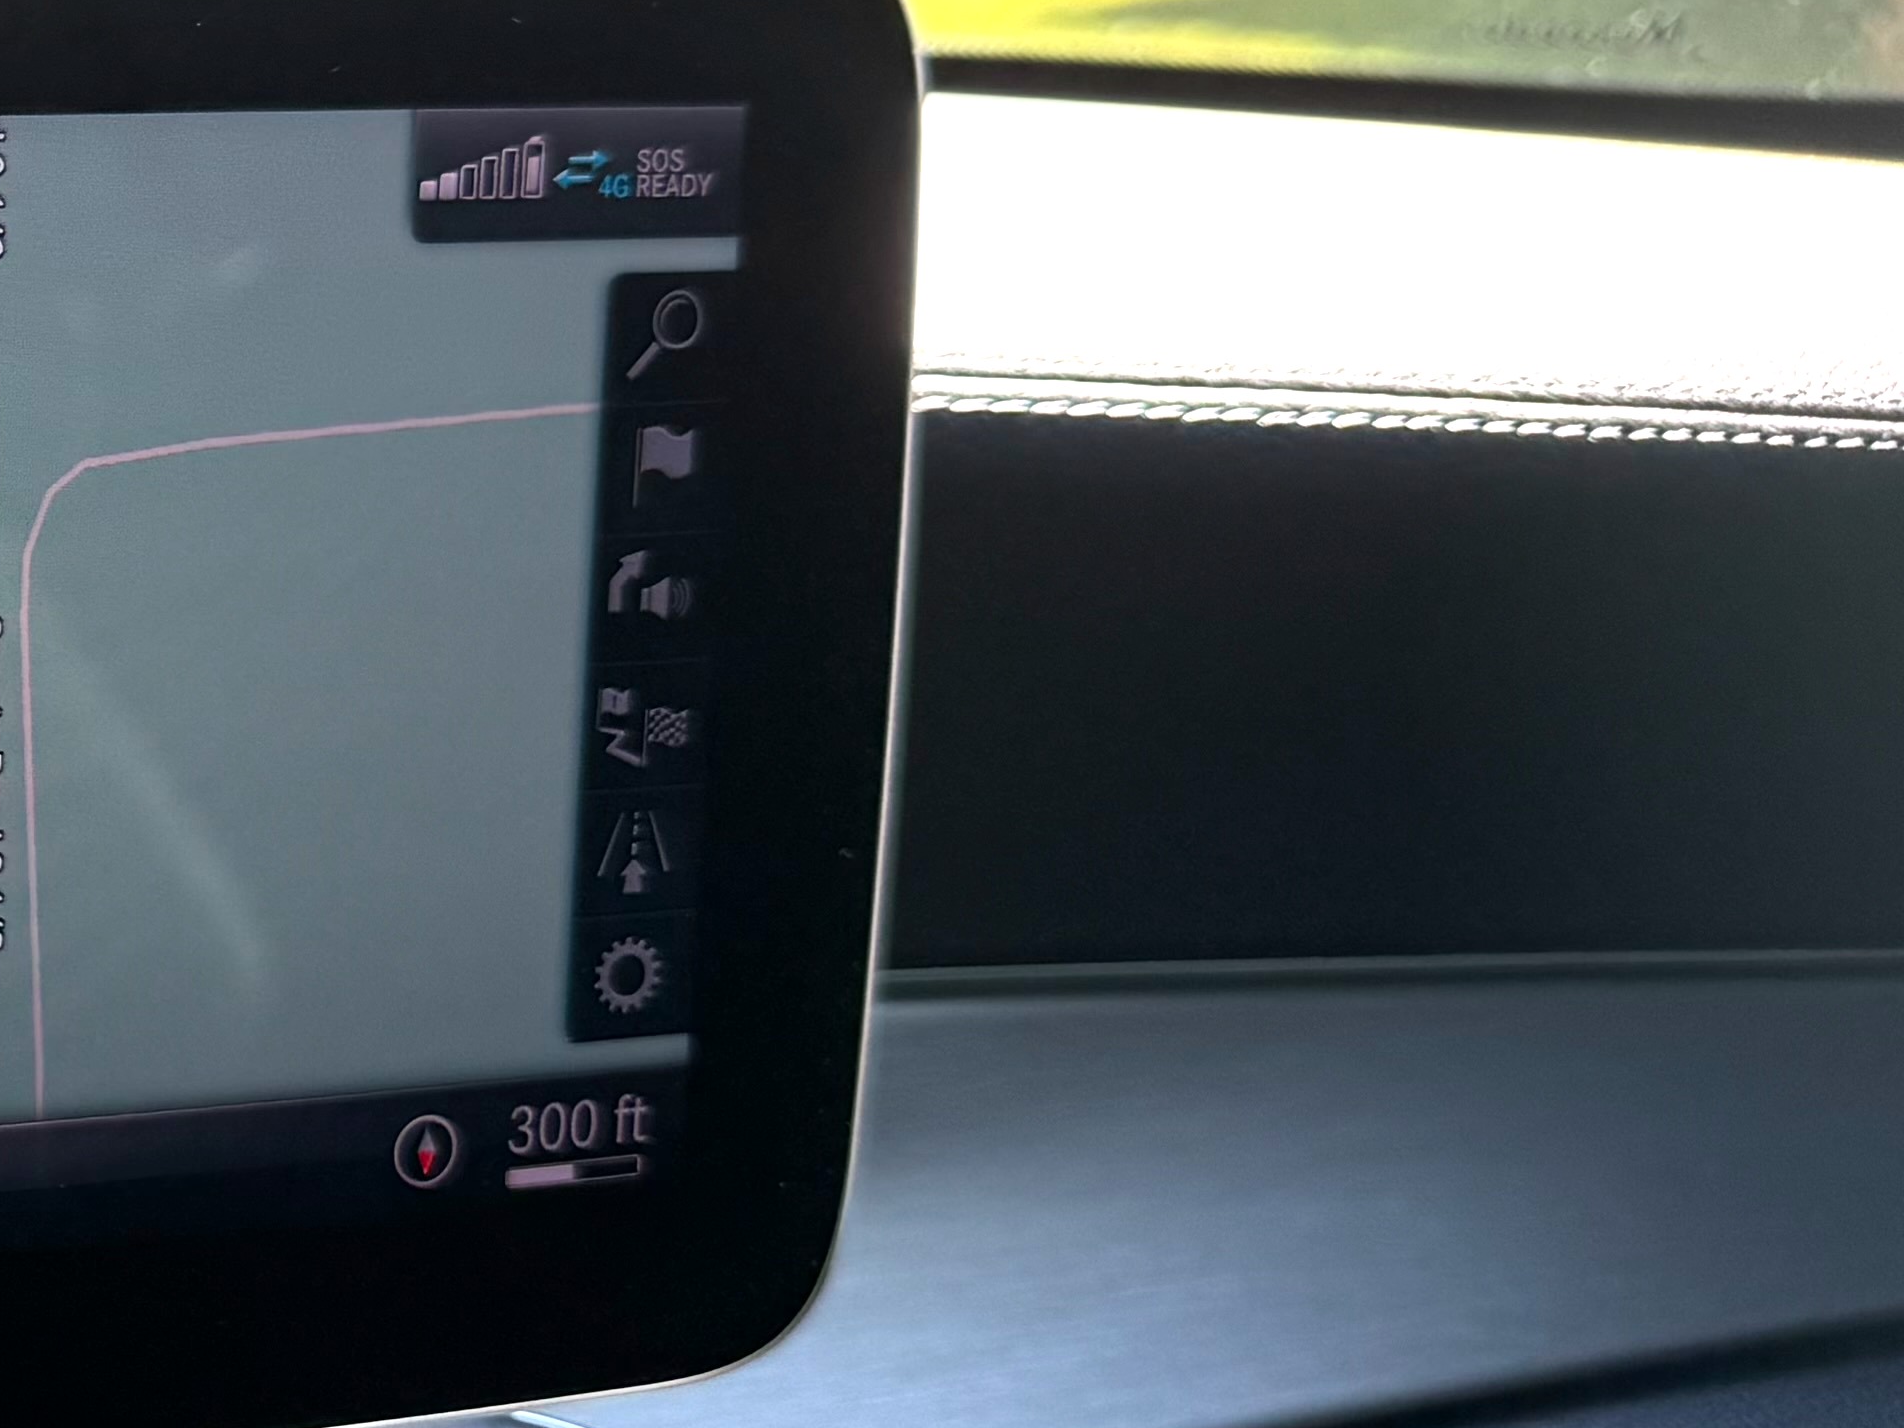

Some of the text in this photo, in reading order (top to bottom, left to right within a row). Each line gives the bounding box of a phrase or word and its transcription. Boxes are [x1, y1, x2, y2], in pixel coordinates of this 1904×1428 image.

[636, 148, 686, 174] SOS
[597, 173, 631, 199] 4G
[635, 173, 713, 199] READY
[506, 1093, 652, 1155] 300 ft
